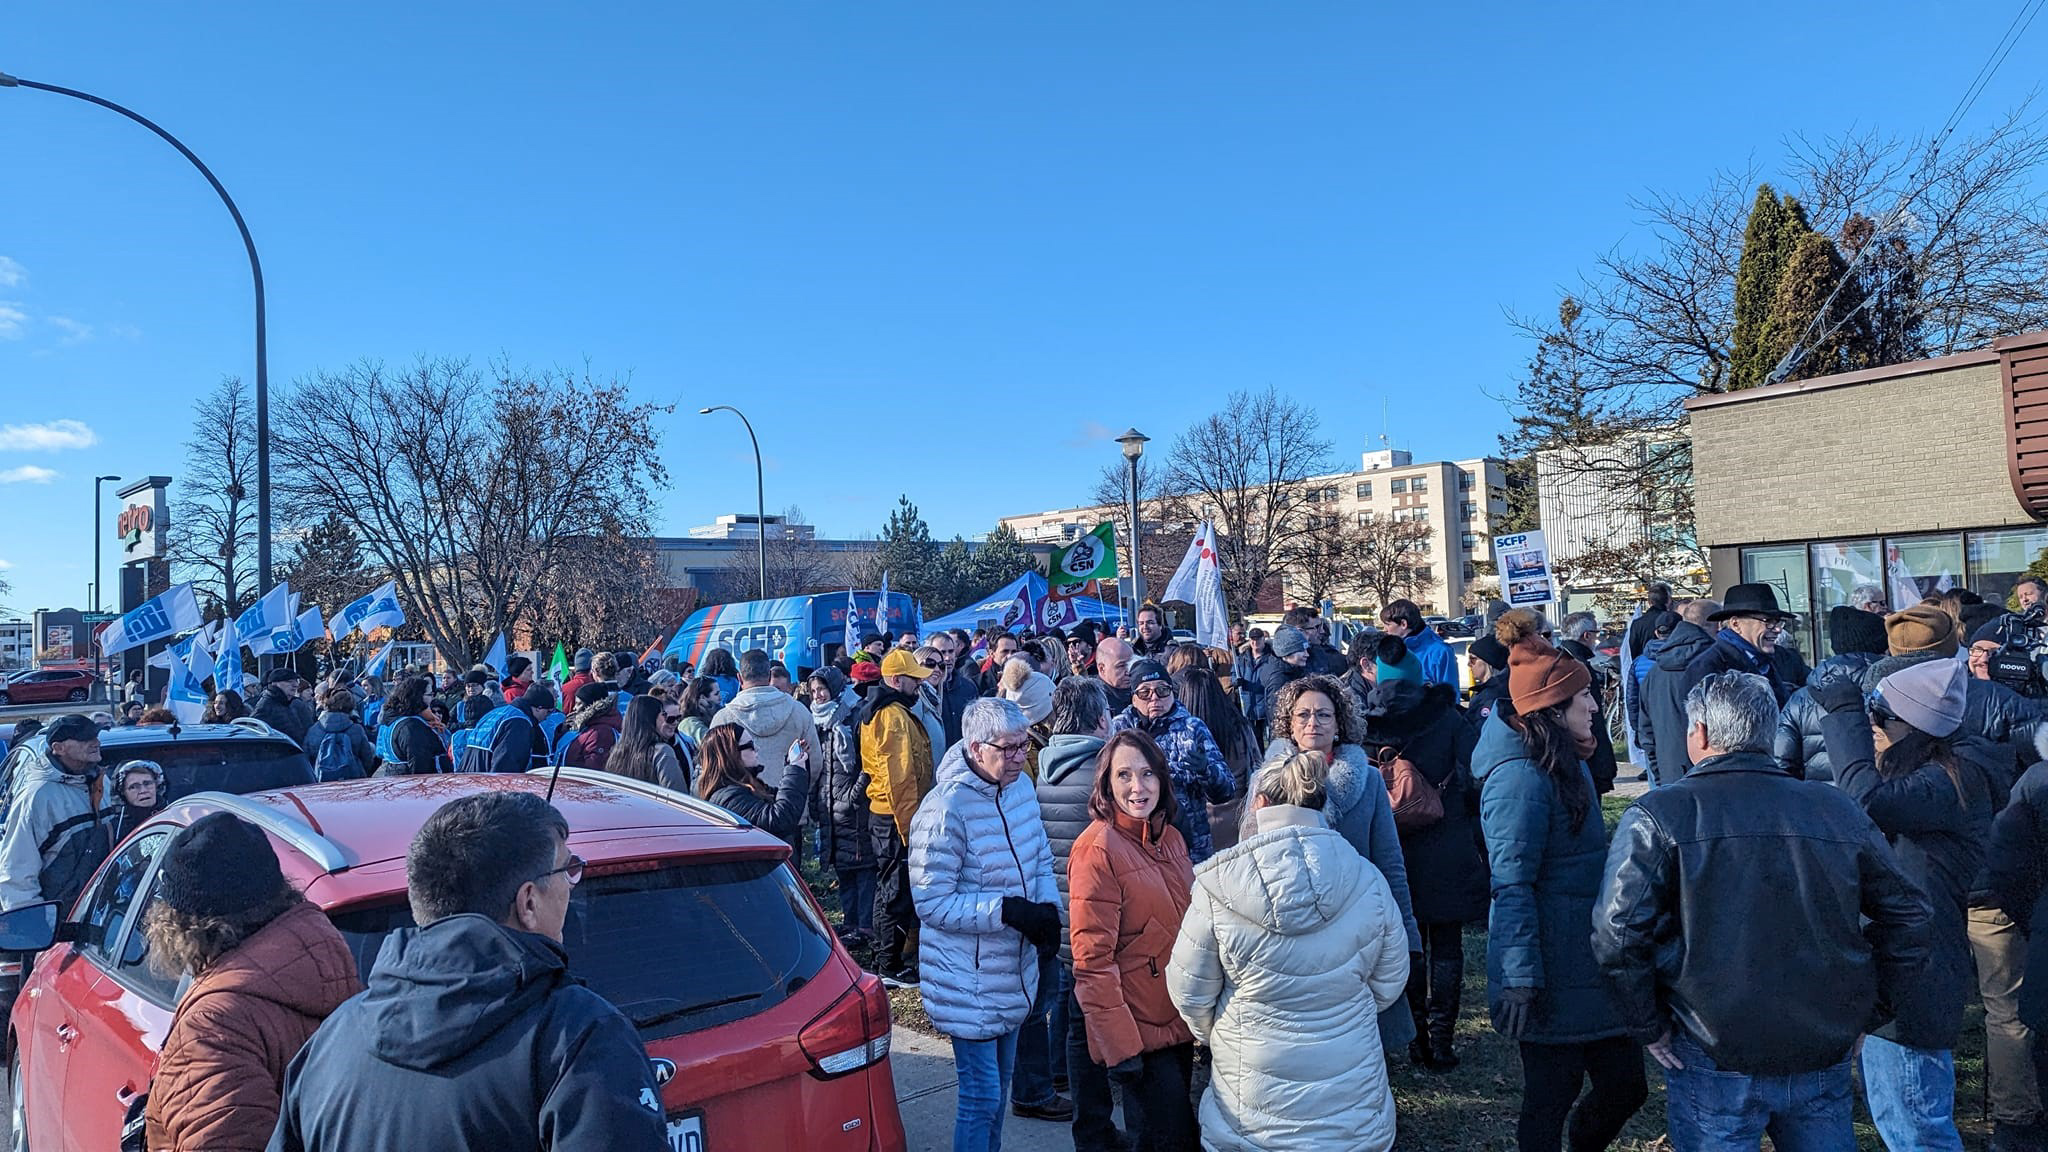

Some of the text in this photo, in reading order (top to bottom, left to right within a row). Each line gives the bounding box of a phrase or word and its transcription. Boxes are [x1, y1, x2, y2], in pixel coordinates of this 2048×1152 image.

[1496, 535, 1527, 548] SCFP
[1070, 559, 1095, 573] CSN
[1048, 612, 1062, 626] CSN
[718, 625, 787, 661] SCFP
[2000, 663, 2026, 671] noovo
[845, 1120, 860, 1129] GDI
